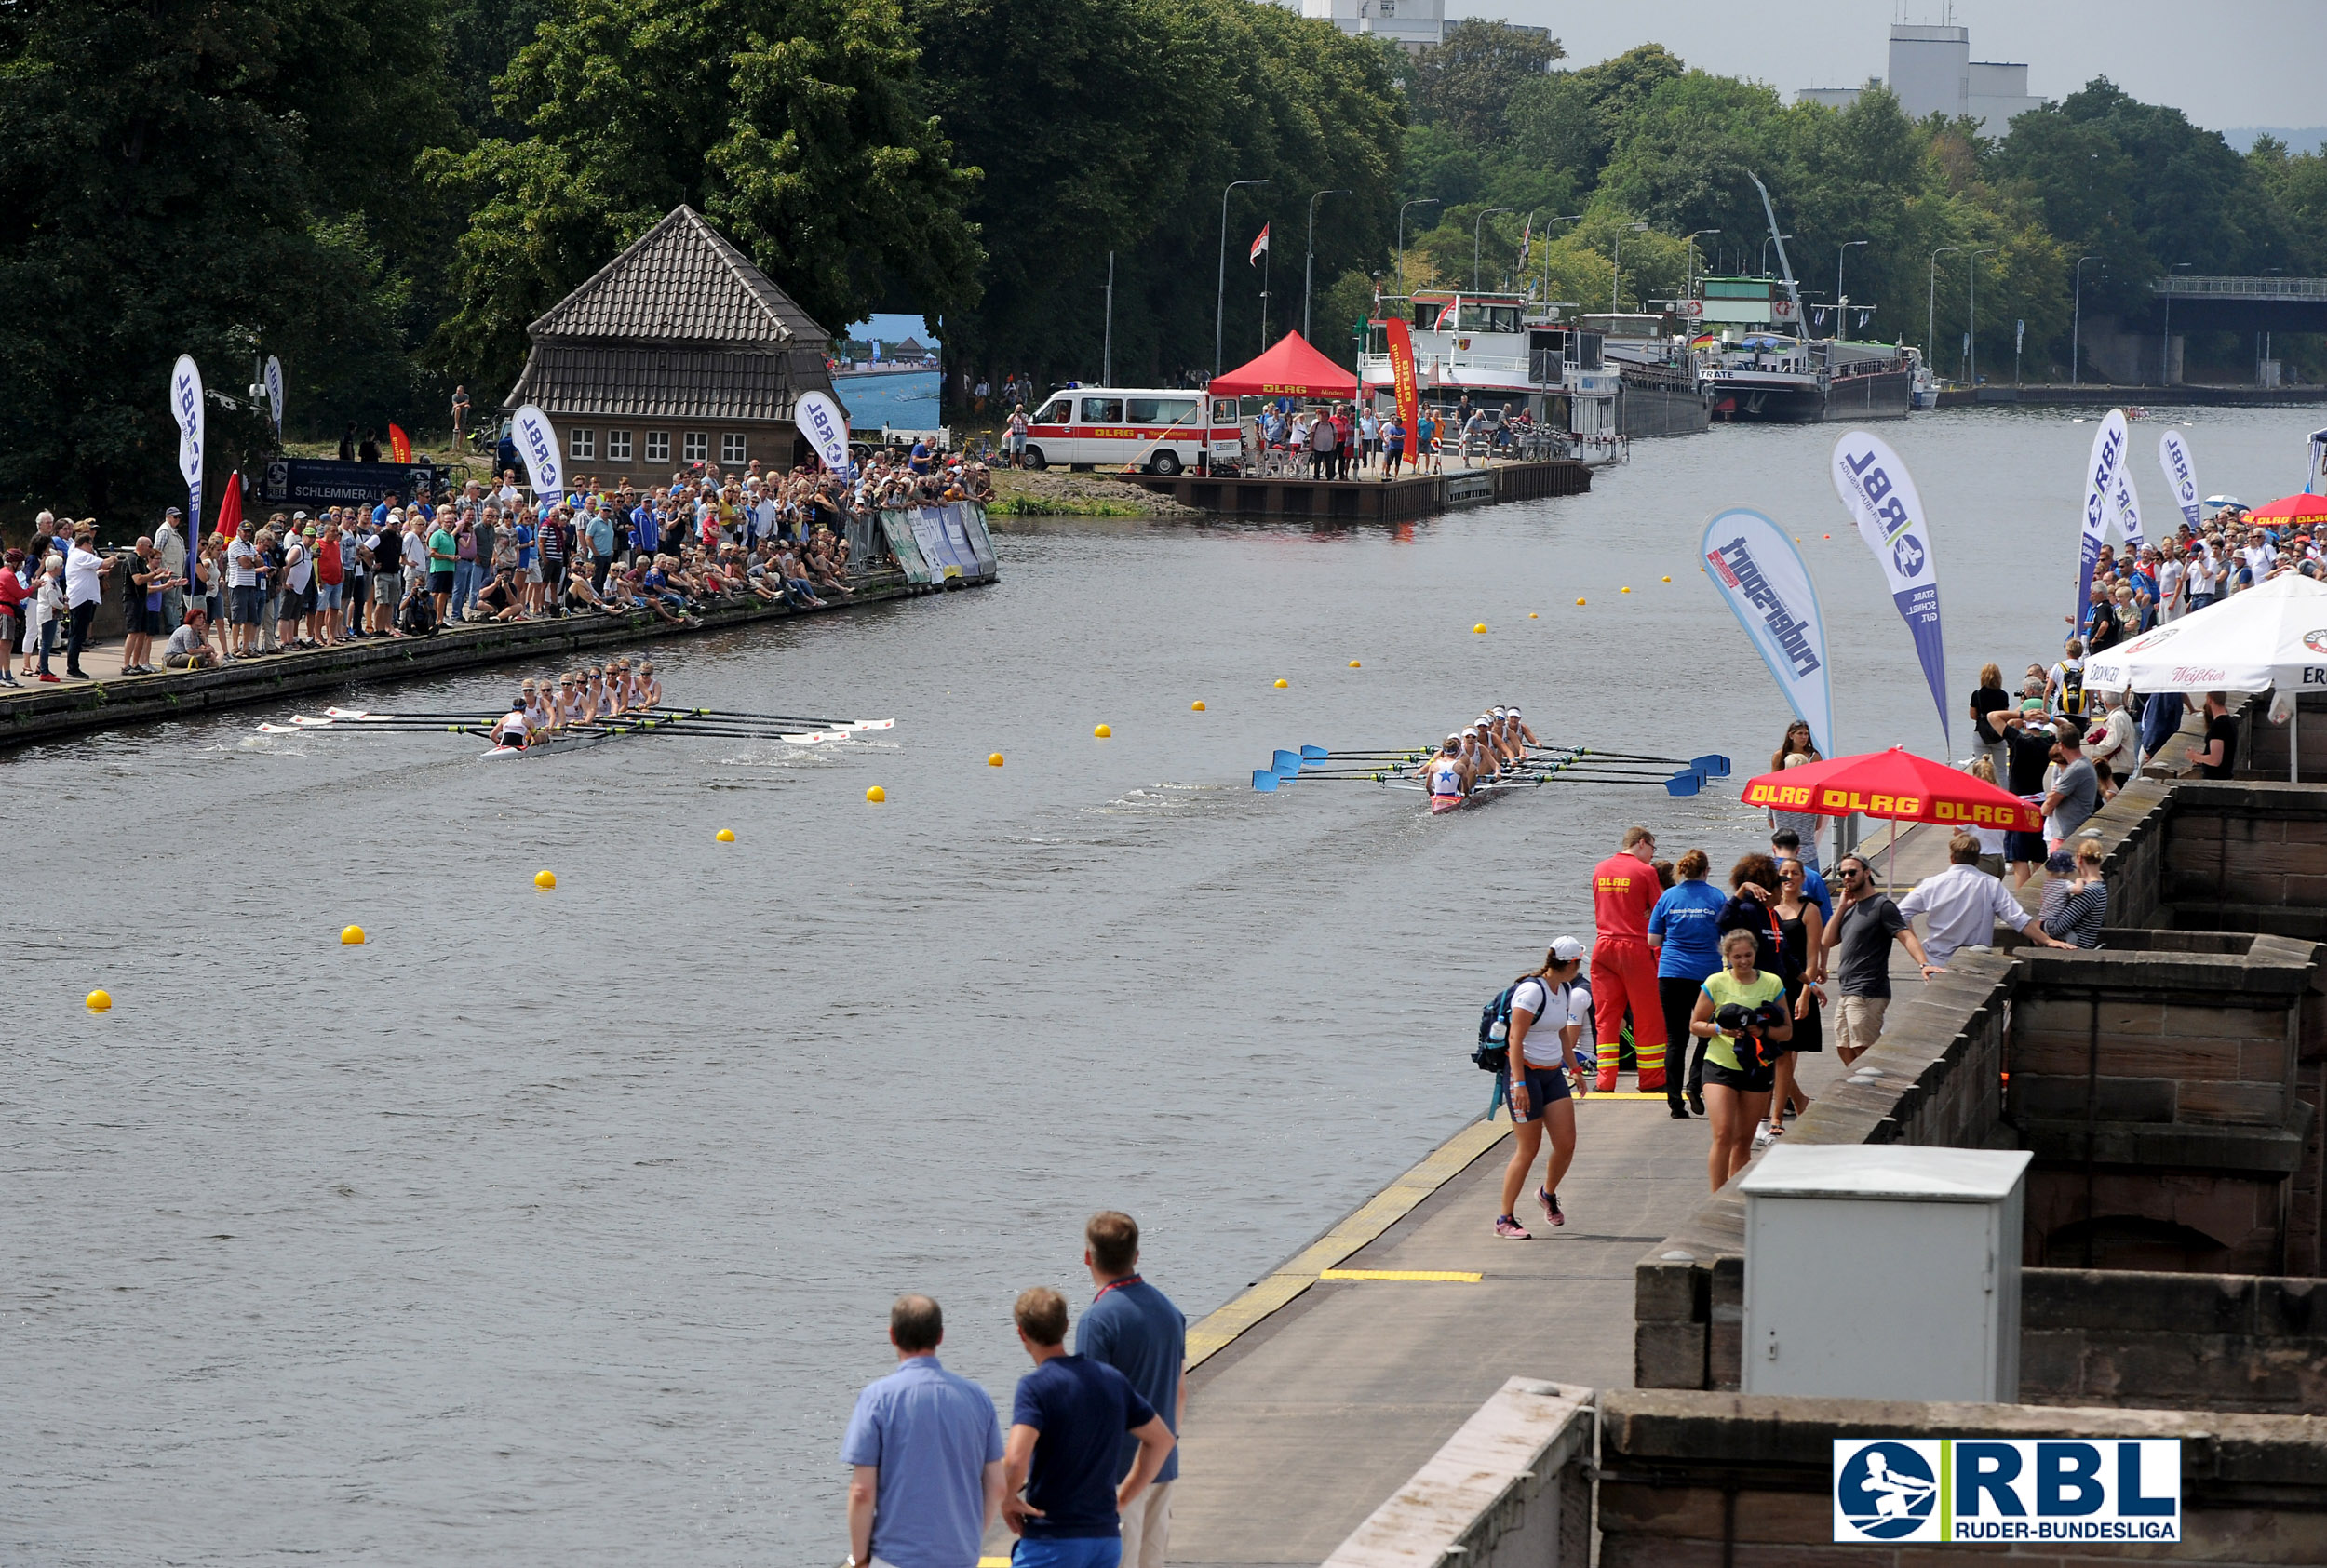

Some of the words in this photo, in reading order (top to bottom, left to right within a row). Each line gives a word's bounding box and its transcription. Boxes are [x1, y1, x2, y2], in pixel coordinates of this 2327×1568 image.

[1263, 384, 1307, 395] DLRG
[1095, 429, 1135, 437] DLRG
[1148, 430, 1188, 438] Wassrettung
[2094, 428, 2121, 494] RBL
[267, 488, 286, 497] RBL
[295, 485, 401, 502] SCHLEMMERALL
[2256, 516, 2290, 525] DLRG
[2172, 666, 2226, 685] Weißbier
[2303, 667, 2327, 684] ER
[1750, 785, 1810, 805] DLRG
[1823, 789, 1919, 813] DLRG
[1935, 801, 2014, 824] DLRG
[1598, 878, 1631, 887] DLRG
